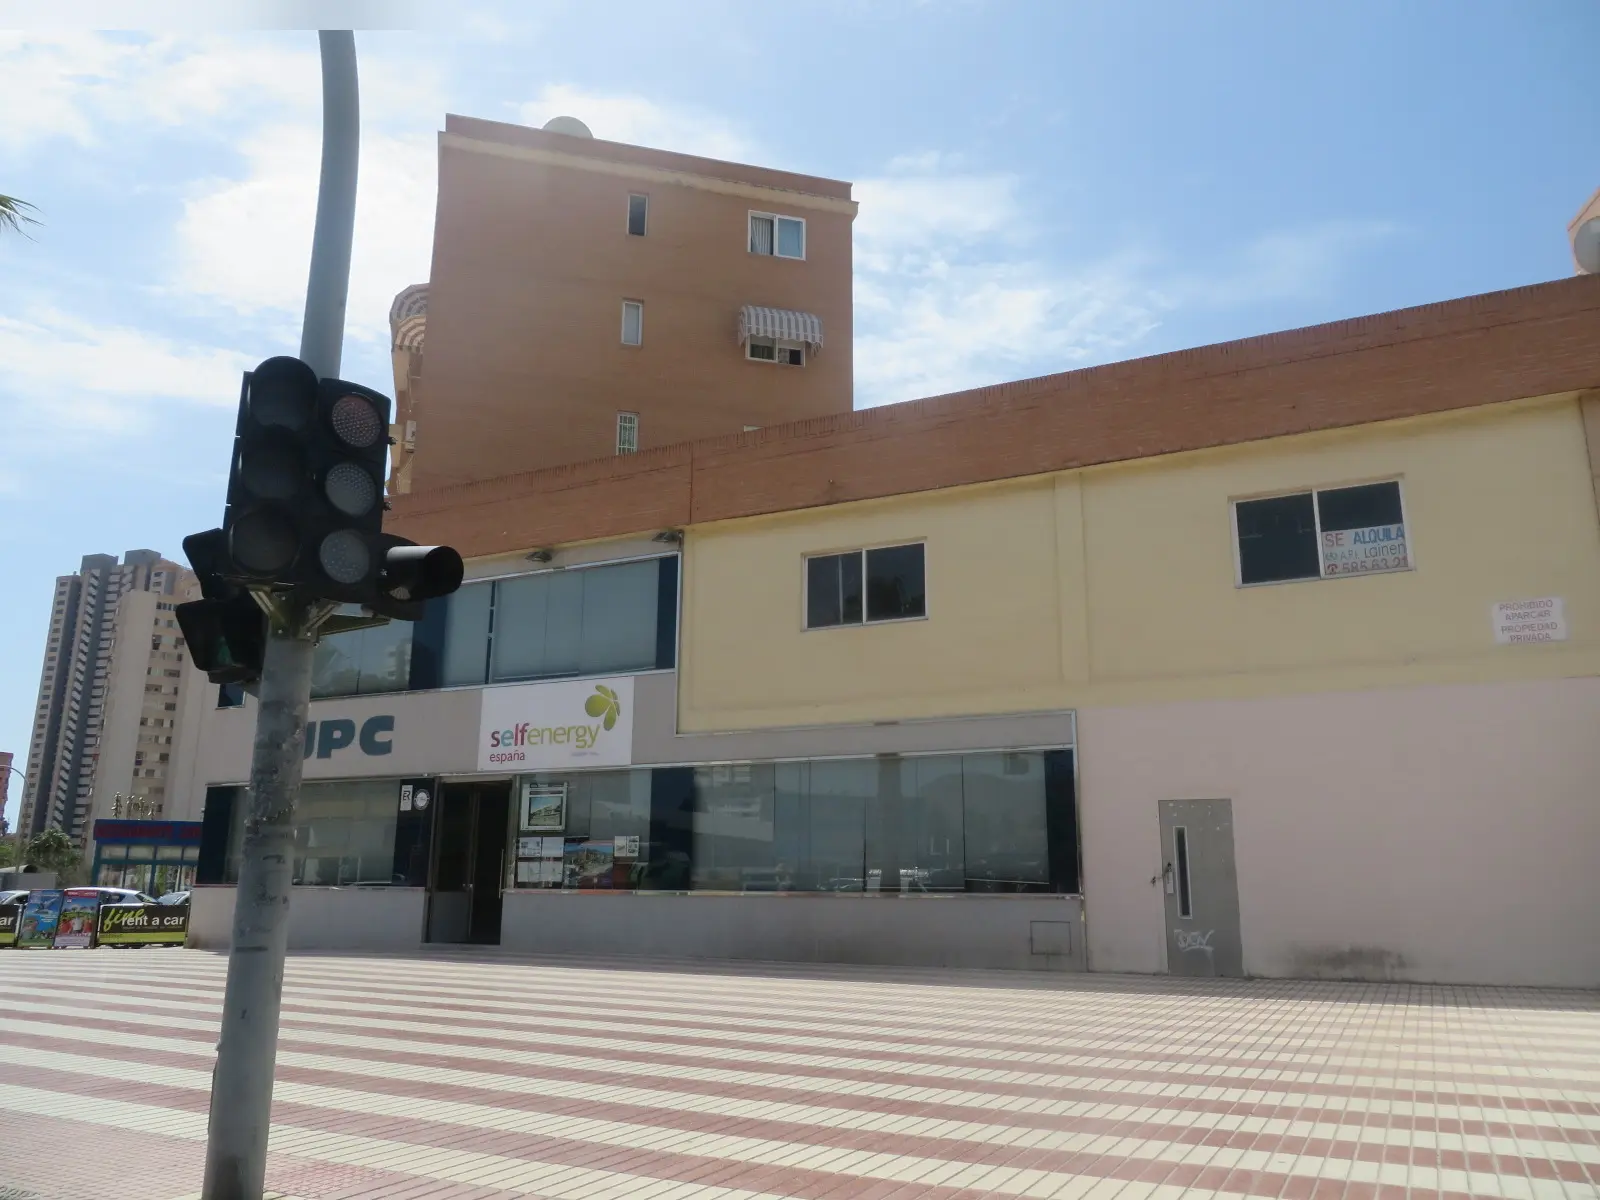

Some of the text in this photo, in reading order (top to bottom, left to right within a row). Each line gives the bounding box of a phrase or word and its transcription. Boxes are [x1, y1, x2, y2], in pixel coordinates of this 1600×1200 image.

[1325, 526, 1405, 547] SE ALQUILA
[1499, 599, 1554, 611] PROHIBIDO
[1505, 609, 1552, 621] APARCAR
[1500, 621, 1558, 634] PROPIEDAD
[1509, 632, 1552, 643] PRIVADA
[490, 722, 600, 749] selfenergy
[489, 749, 526, 764] españa
[103, 908, 146, 932] fine
[121, 914, 185, 926] rent a car
